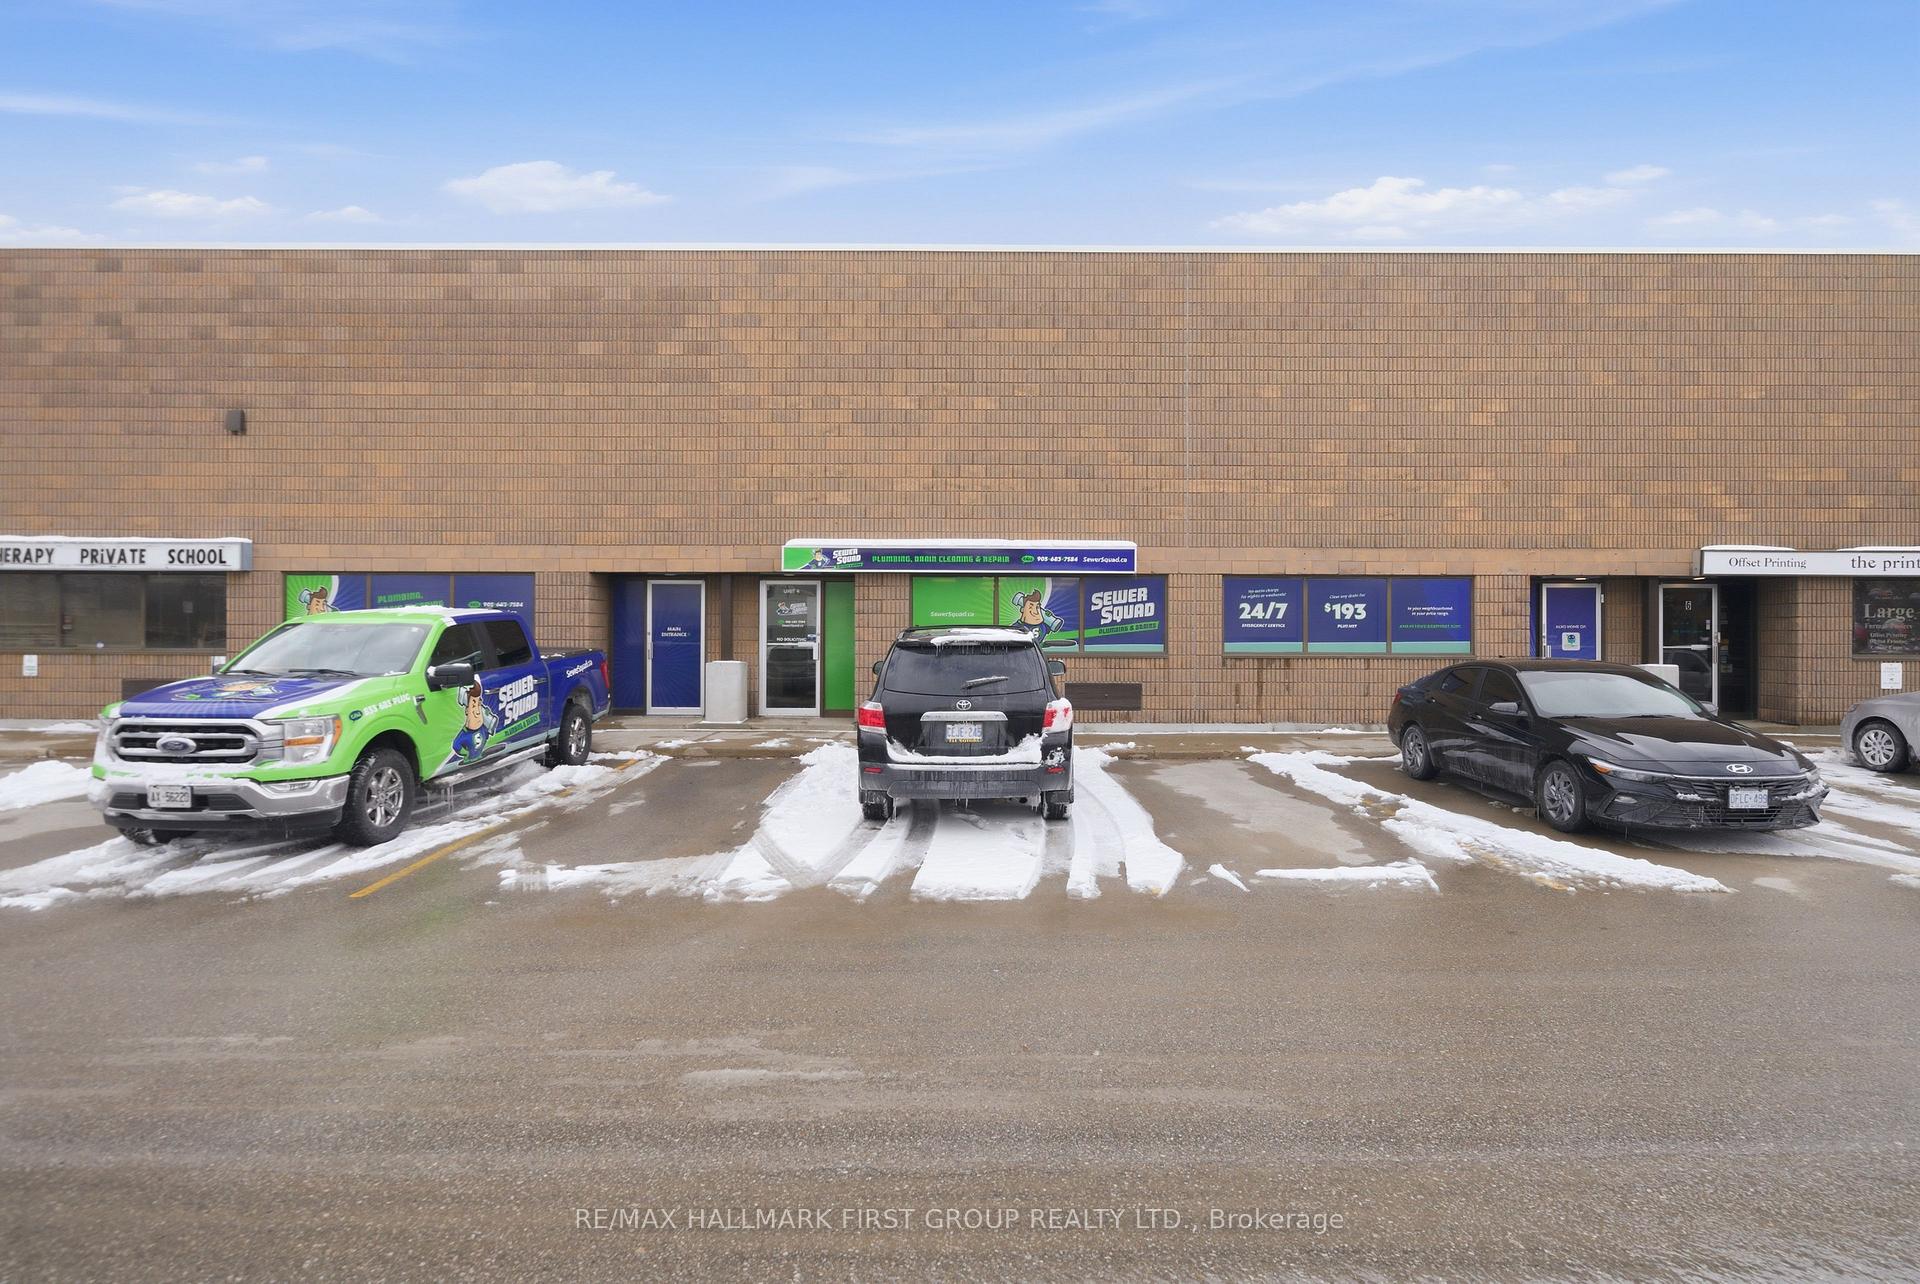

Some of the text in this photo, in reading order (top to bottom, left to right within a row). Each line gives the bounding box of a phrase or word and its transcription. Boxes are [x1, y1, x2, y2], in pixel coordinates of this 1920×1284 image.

[168, 548, 227, 564] SCHOOL
[832, 548, 858, 559] SEWER
[836, 554, 861, 564] SQUAD
[1728, 556, 1760, 568] Offset
[1764, 556, 1807, 569] Printing
[1851, 556, 1876, 569] the
[1091, 587, 1148, 611] SEWER
[1100, 602, 1155, 625] SQUAD
[1239, 601, 1288, 619] 24/7
[1324, 602, 1367, 620] $193
[1863, 603, 1914, 623] Large
[498, 674, 534, 711] SEWER
[503, 692, 538, 727] SQUAD
